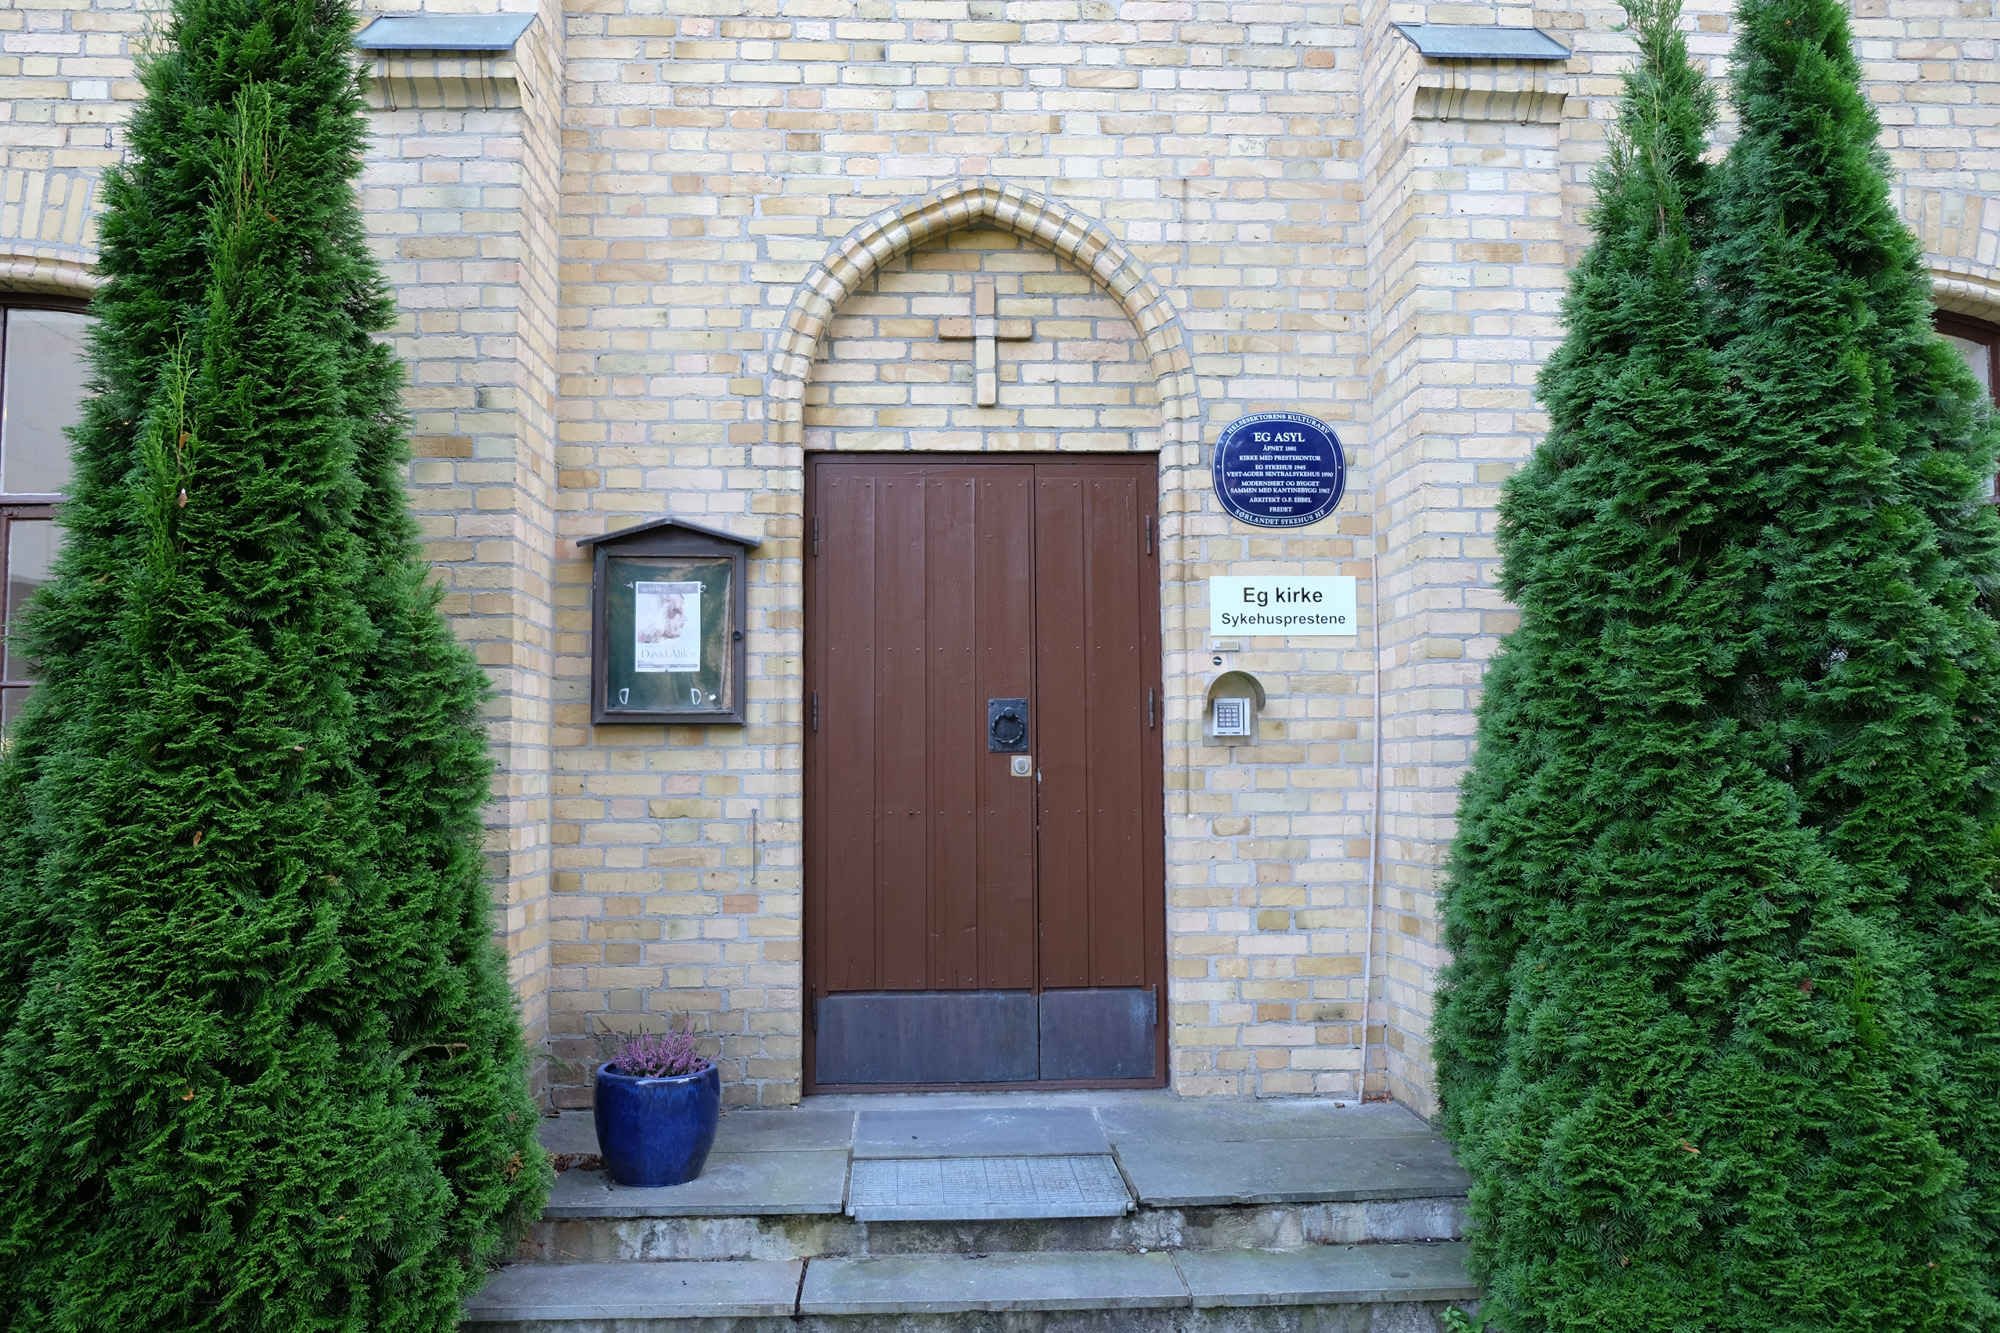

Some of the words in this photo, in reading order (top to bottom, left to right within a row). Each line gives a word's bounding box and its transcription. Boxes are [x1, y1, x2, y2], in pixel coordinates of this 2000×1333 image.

[1227, 414, 1286, 434] HELSESEKTORENS
[1288, 414, 1329, 434] KULTURARV
[1254, 432, 1270, 442] EG
[1274, 432, 1305, 442] ASYL
[1235, 509, 1279, 524] SØRLANDET
[1280, 512, 1314, 524] SYKEHUS
[1315, 508, 1325, 518] HF
[1243, 587, 1268, 607] Eg
[1276, 587, 1323, 602] kirke
[1221, 612, 1346, 627] Sykehusprestene
[641, 649, 668, 658] David
